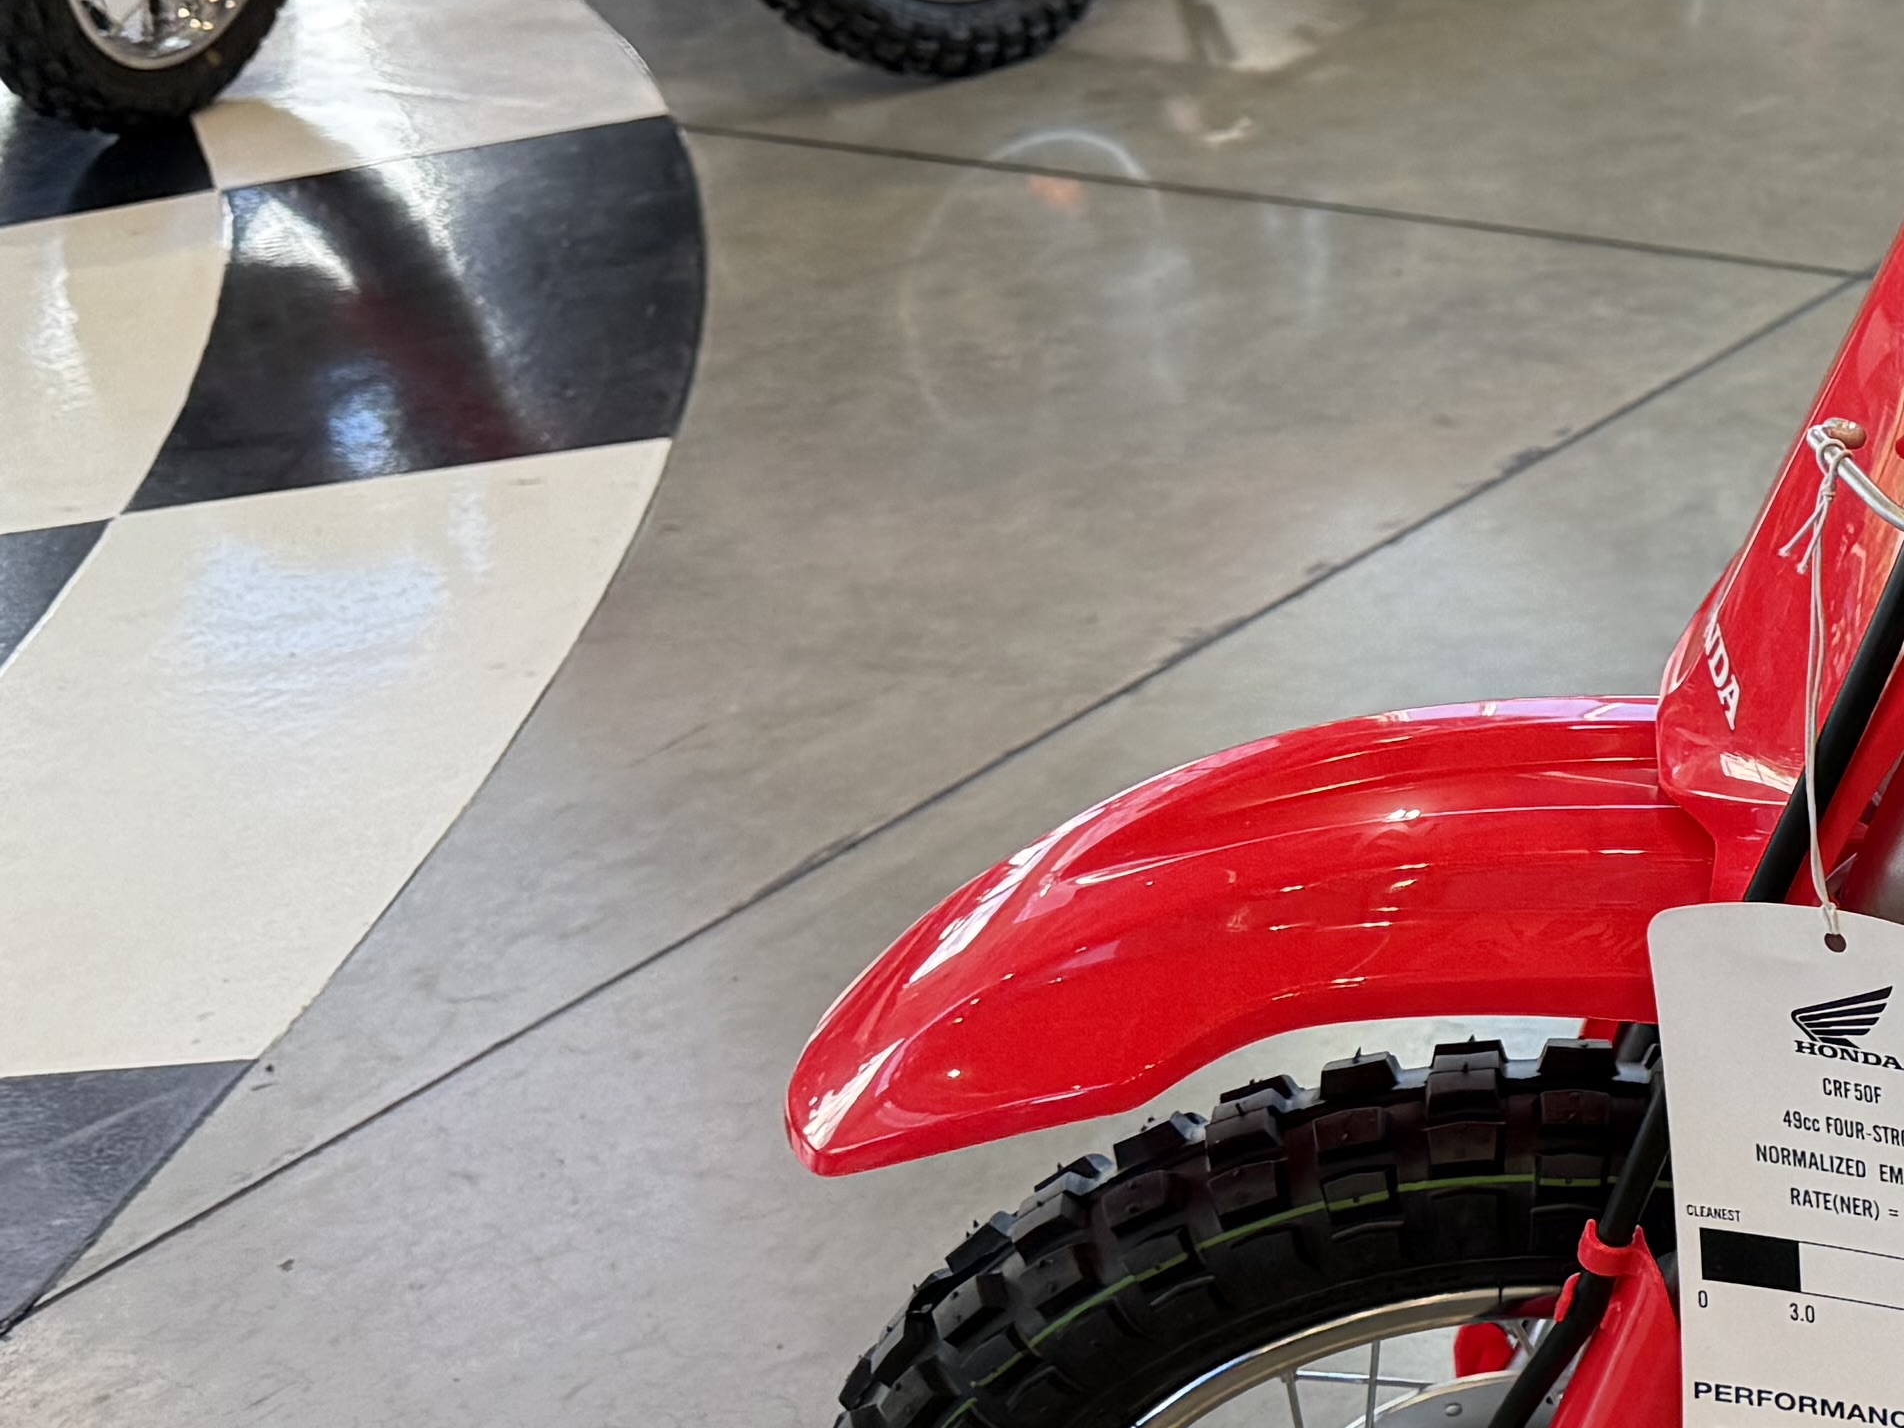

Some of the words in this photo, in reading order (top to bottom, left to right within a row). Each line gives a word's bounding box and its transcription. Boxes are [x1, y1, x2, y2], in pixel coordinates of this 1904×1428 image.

[1794, 1039, 1904, 1071] HONDA
[1822, 1077, 1882, 1104] CRF50F
[1782, 1109, 1821, 1133] 49cc
[1755, 1143, 1866, 1178] NORMALIZED
[1686, 1204, 1741, 1222] CLEANEST
[1790, 1187, 1880, 1221] RATE(NER)
[1888, 1208, 1899, 1218] =
[1697, 1289, 1709, 1309] 0
[1789, 1302, 1816, 1324] 3.0
